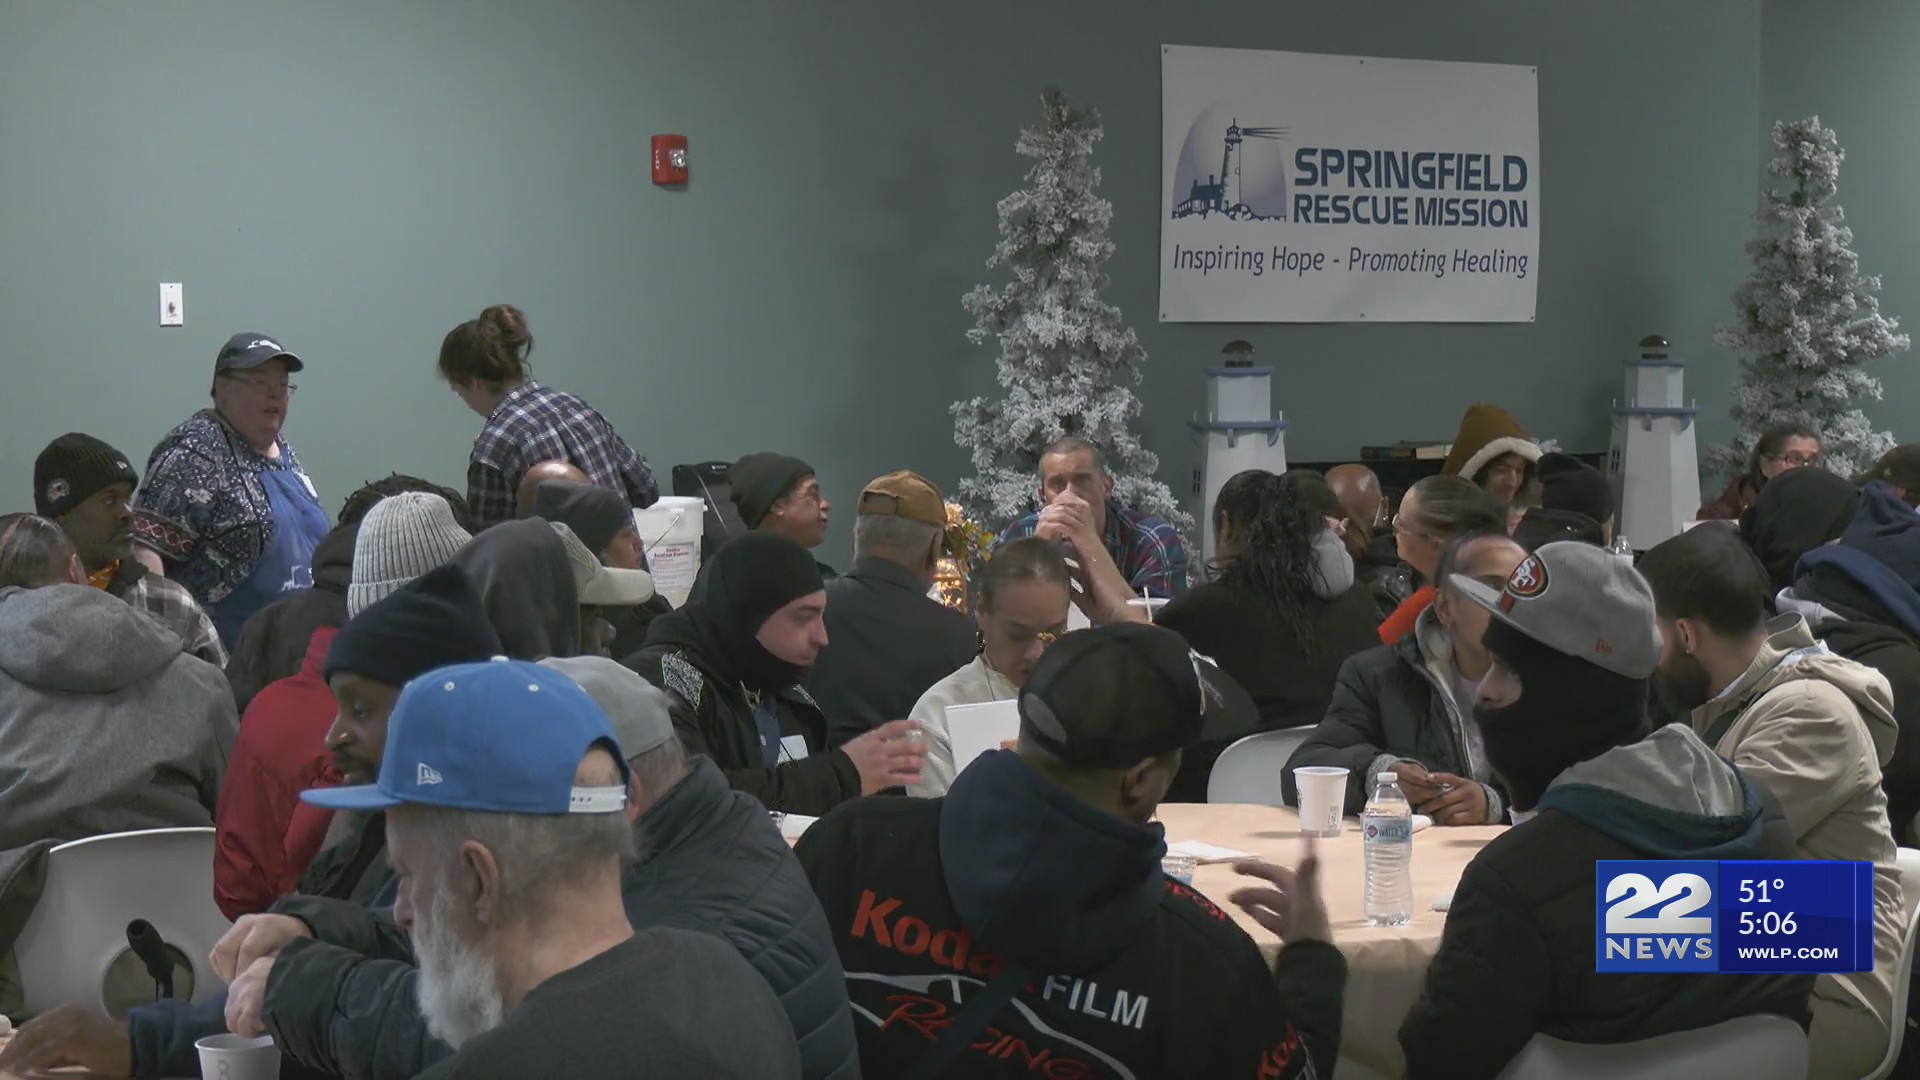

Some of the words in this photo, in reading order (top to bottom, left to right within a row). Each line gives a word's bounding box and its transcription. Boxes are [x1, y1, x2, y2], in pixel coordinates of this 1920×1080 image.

[1294, 147, 1529, 193] SPRINGFIELD
[1293, 194, 1409, 226] RESCUE
[1414, 196, 1529, 228] MISSION
[1173, 243, 1265, 277] Inspiring
[1271, 245, 1326, 277] Hope
[1348, 246, 1447, 278] Promoting
[1452, 248, 1530, 279] Healing
[850, 888, 1034, 994] Koda
[1042, 975, 1150, 1030] FILM
